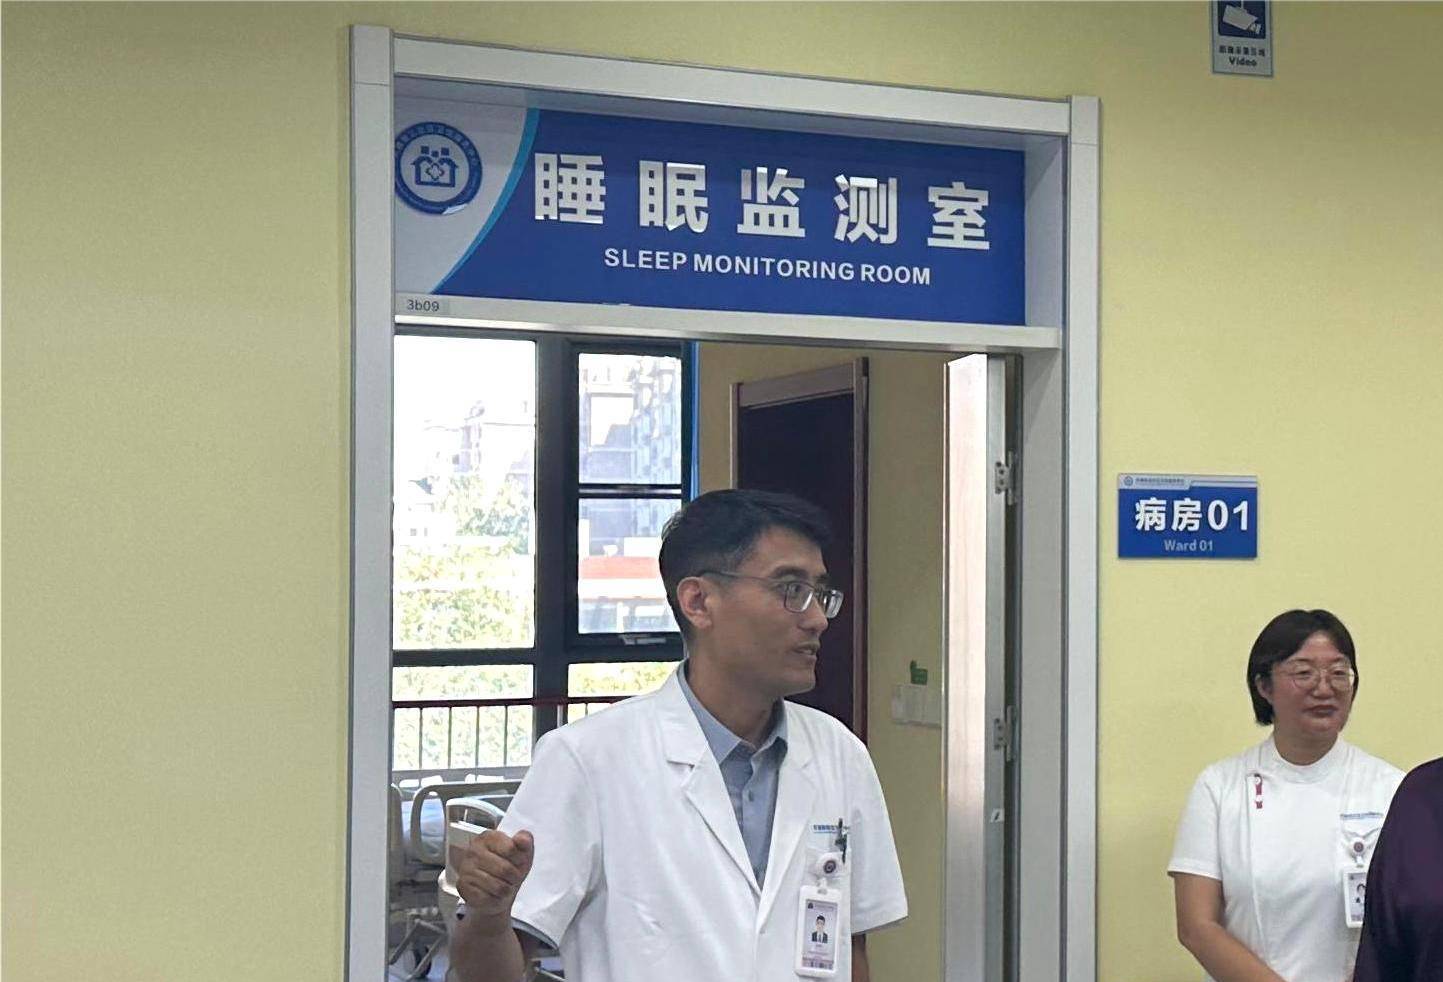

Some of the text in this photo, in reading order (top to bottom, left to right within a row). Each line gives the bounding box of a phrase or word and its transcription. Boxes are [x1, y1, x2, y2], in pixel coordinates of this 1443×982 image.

[1229, 56, 1257, 67] Video
[534, 152, 991, 250] 睡眠监测室
[604, 247, 931, 286] SLEEP MONITORING ROOM
[406, 299, 440, 313] 3b09
[1134, 496, 1249, 532] 病房01
[1163, 539, 1214, 552] Ward 01
